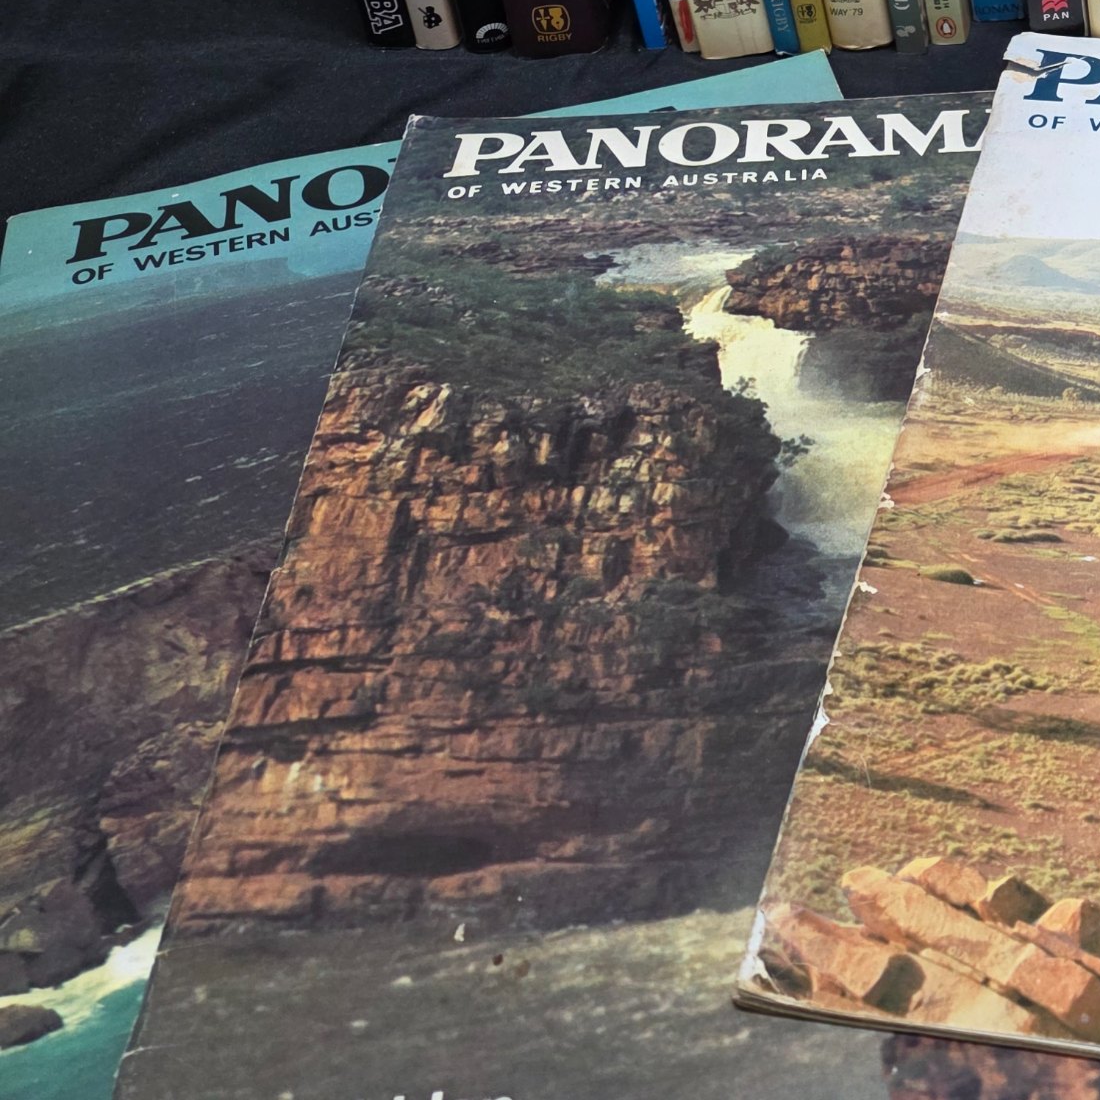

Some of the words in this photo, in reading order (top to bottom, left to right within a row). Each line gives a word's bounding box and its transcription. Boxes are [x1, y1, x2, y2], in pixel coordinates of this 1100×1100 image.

[1043, 11, 1070, 21] PAN
[537, 33, 572, 43] RIGBY
[1028, 114, 1067, 130] OF
[447, 185, 482, 199] OF
[502, 175, 643, 197] WESTERN
[663, 168, 828, 188] AUSTRALIA
[66, 158, 396, 264] PANO
[71, 263, 115, 285] OF
[133, 227, 290, 272] WESTERN
[309, 209, 381, 237] AUS
